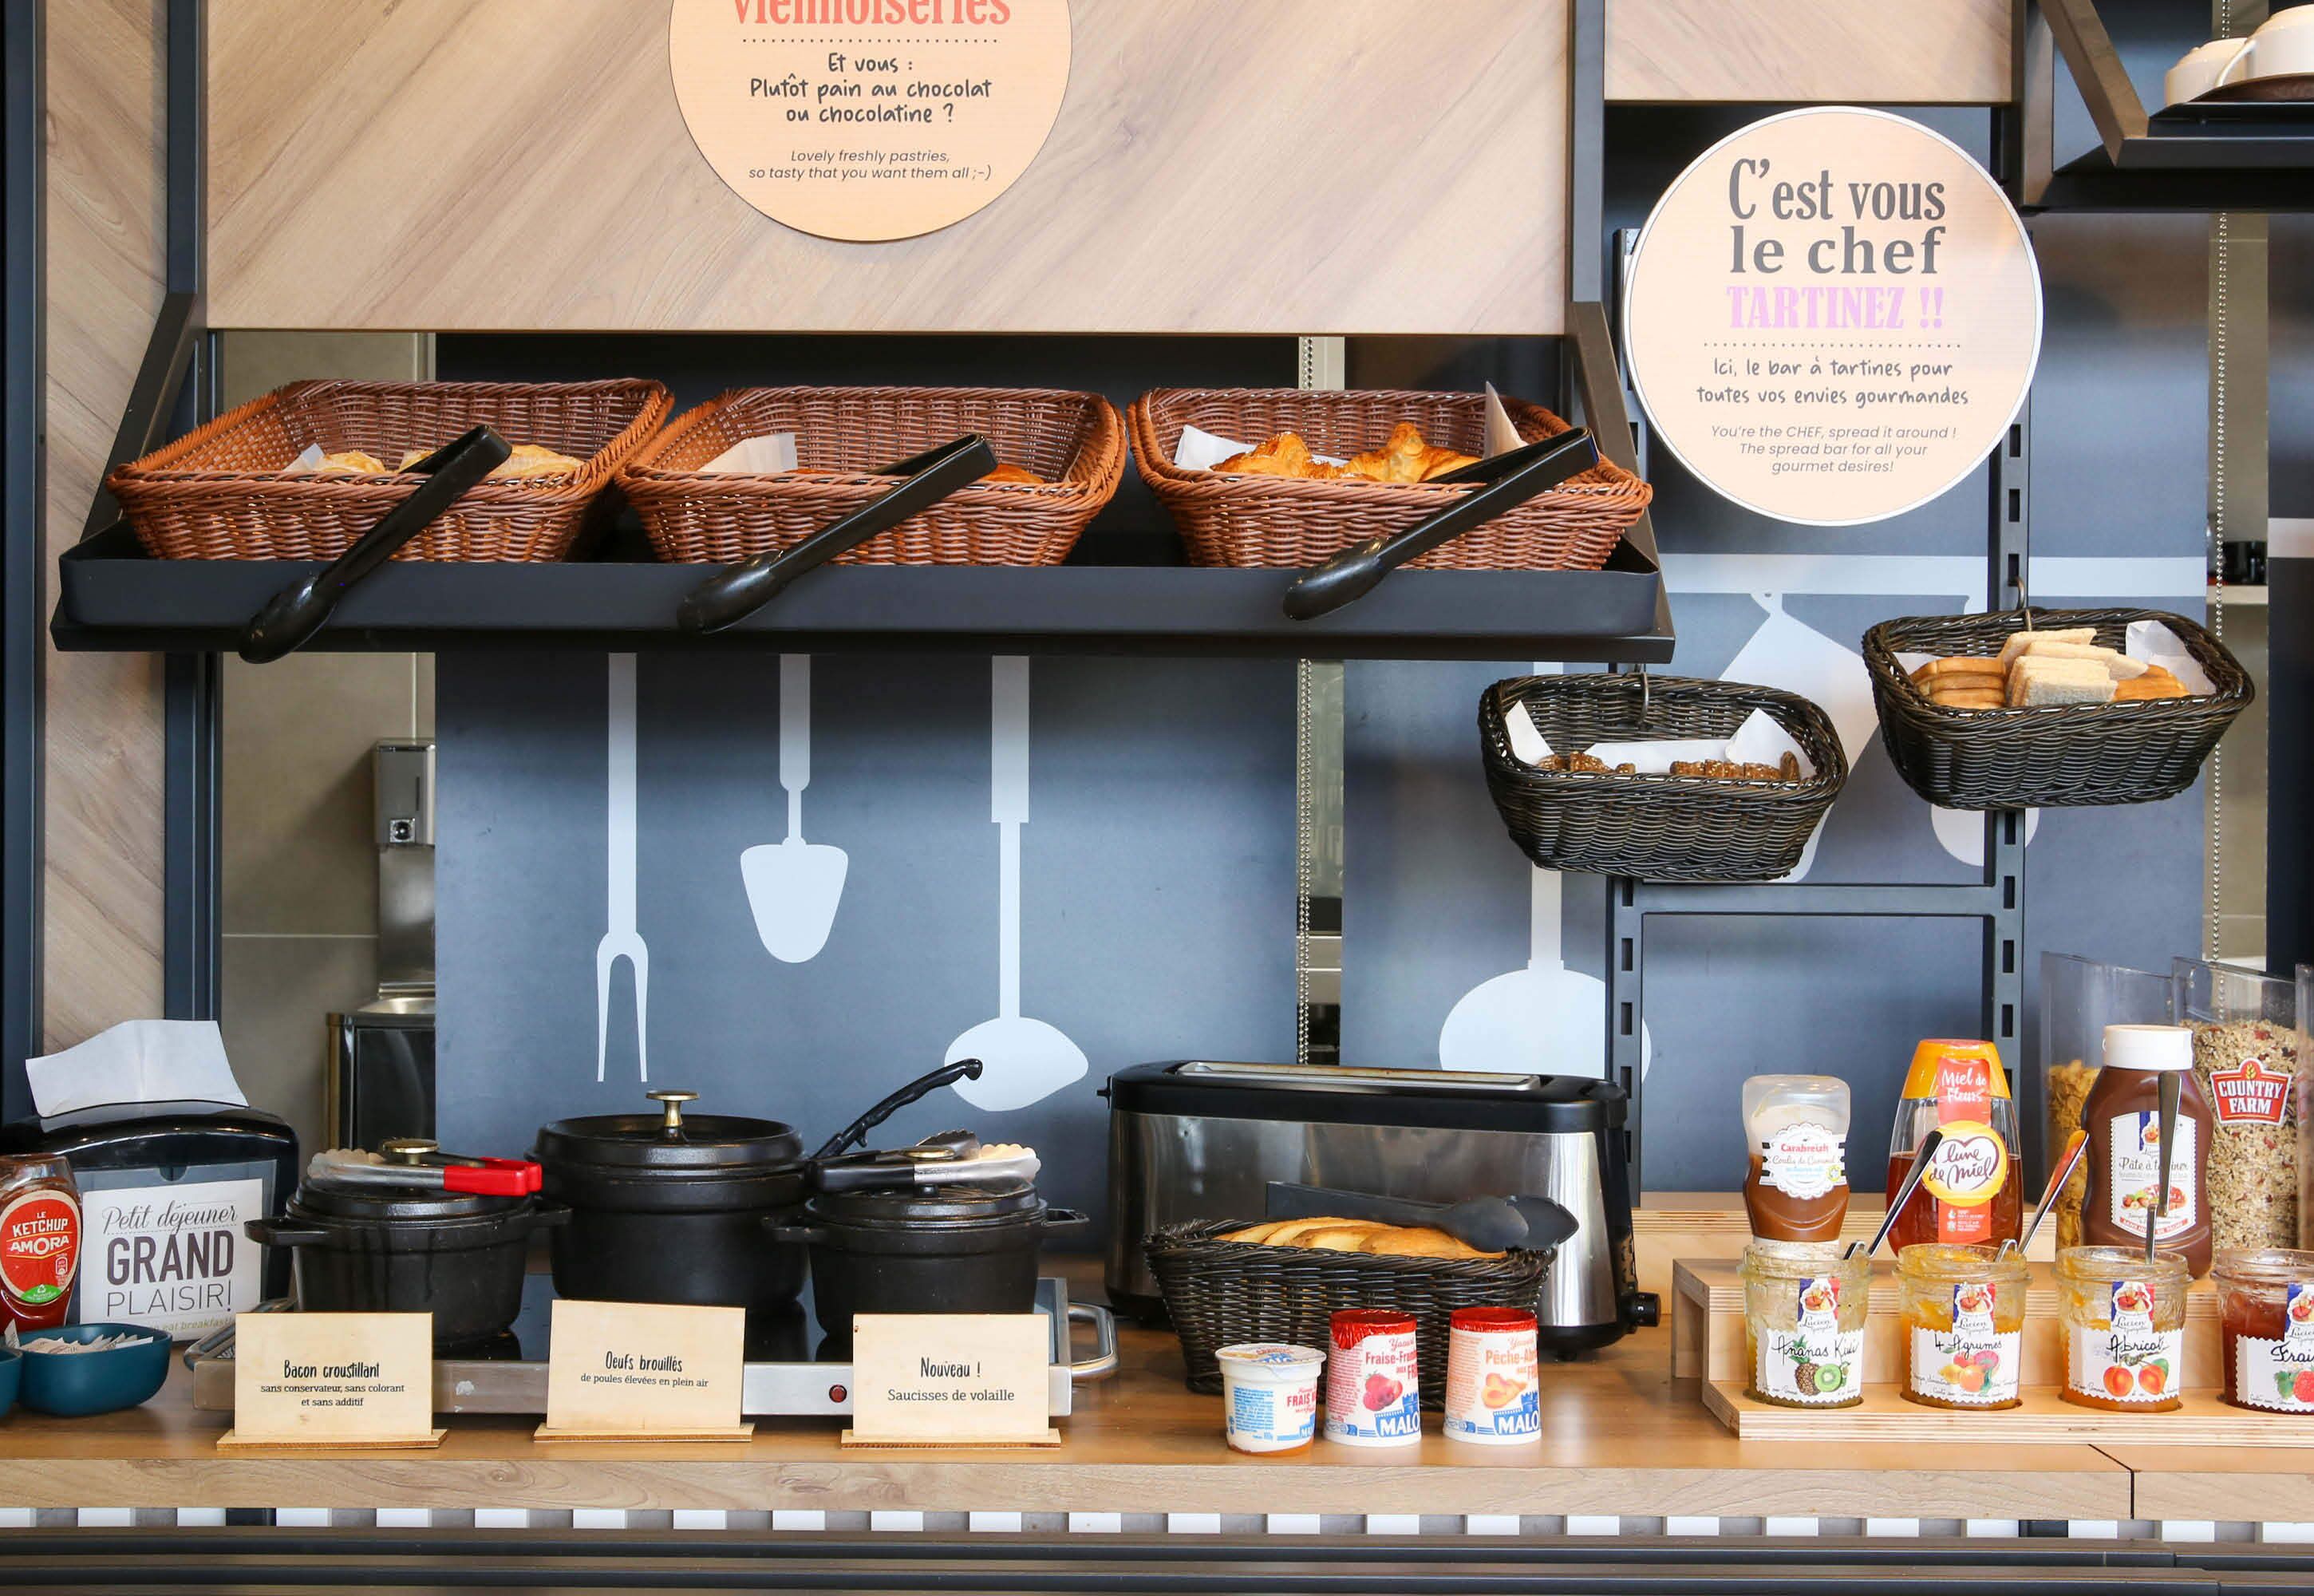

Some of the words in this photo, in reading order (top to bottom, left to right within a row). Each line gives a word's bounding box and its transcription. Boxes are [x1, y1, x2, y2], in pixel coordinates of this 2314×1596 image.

[827, 52, 847, 73] Et
[854, 57, 899, 73] vous
[750, 73, 809, 98] Plutôt
[817, 79, 862, 103] pain
[871, 85, 898, 97] au
[906, 79, 993, 98] chocolat
[786, 109, 810, 122] ou
[819, 105, 933, 124] chocolatine
[942, 104, 954, 124] ?
[791, 150, 835, 163] Lovely
[839, 149, 887, 163] freshly
[889, 150, 950, 164] pastries,
[748, 169, 766, 179] so
[769, 168, 804, 181] tasty
[808, 167, 839, 179] that
[841, 169, 868, 182] you
[871, 168, 907, 179] want
[910, 167, 948, 179] them
[951, 167, 969, 179] all
[1847, 182, 1946, 221] vous
[1729, 225, 1785, 275] le
[1807, 225, 1947, 275] chef
[1727, 286, 1905, 329] TARTINEZ
[1920, 286, 1944, 329] !!
[1714, 358, 1737, 377] Ici,
[1746, 359, 1760, 376] le
[1768, 360, 1802, 376] bar
[1810, 355, 1822, 375] à
[1829, 360, 1902, 377] tartines
[1909, 364, 1953, 382] pour
[1696, 386, 1750, 404] toutes
[1757, 390, 1786, 404] vos
[1794, 387, 1847, 405] envies
[1855, 386, 1968, 409] gourmandes
[1711, 425, 1755, 438] You're
[1759, 425, 1783, 438] the
[1785, 426, 1825, 440] CHEF,
[1828, 426, 1880, 442] spread
[1883, 426, 1893, 438] it
[1895, 426, 1949, 439] around
[1739, 443, 1766, 455] The
[1768, 443, 1820, 459] spread
[1822, 443, 1849, 456] bar
[1851, 443, 1871, 456] for
[1874, 443, 1893, 456] all
[1895, 446, 1929, 459] your
[1771, 461, 1835, 475] gourmet
[1838, 460, 1894, 473] desires!
[1941, 1067, 1973, 1086] Miel
[1947, 1087, 1984, 1104] Fleurs
[2218, 1080, 2284, 1099] COUNTRY
[2229, 1097, 2273, 1115] FARM
[1944, 1144, 1984, 1164] lune
[2119, 1157, 2143, 1171] Pâte
[1929, 1167, 1945, 1182] de
[1947, 1157, 1992, 1190] miel
[102, 1204, 154, 1234] Petit
[157, 1200, 239, 1234] déjeuner
[12, 1219, 69, 1238] KETCHUP
[10, 1235, 69, 1255] AMORA
[107, 1230, 235, 1286] GRAND
[106, 1279, 231, 1317] PLAISIR!
[2285, 1326, 2314, 1338] Lucie
[1771, 1335, 1830, 1366] Ananas
[1934, 1333, 1945, 1350] 4
[1948, 1334, 2003, 1360] Agrumes
[2106, 1334, 2171, 1363] Abricot
[2270, 1341, 2314, 1363] Frai
[283, 1360, 318, 1379] Bacon
[322, 1361, 380, 1379] croustillant
[605, 1351, 634, 1371] Oeufs
[639, 1355, 683, 1373] brouillés
[920, 1357, 970, 1378] Nouveau
[283, 1385, 343, 1393] conservateur,
[368, 1384, 405, 1393] colorant
[580, 1373, 591, 1382] de
[594, 1374, 622, 1385] poules
[624, 1375, 657, 1385] élevées
[672, 1377, 694, 1389] plein
[696, 1379, 709, 1388] air
[334, 1397, 365, 1407] additif
[887, 1389, 949, 1401] Saucisses
[951, 1389, 967, 1401] de
[969, 1389, 1015, 1401] volaille
[1286, 1393, 1310, 1408] FRAIS
[1379, 1411, 1420, 1436] MALO
[1498, 1411, 1539, 1435] MALO
